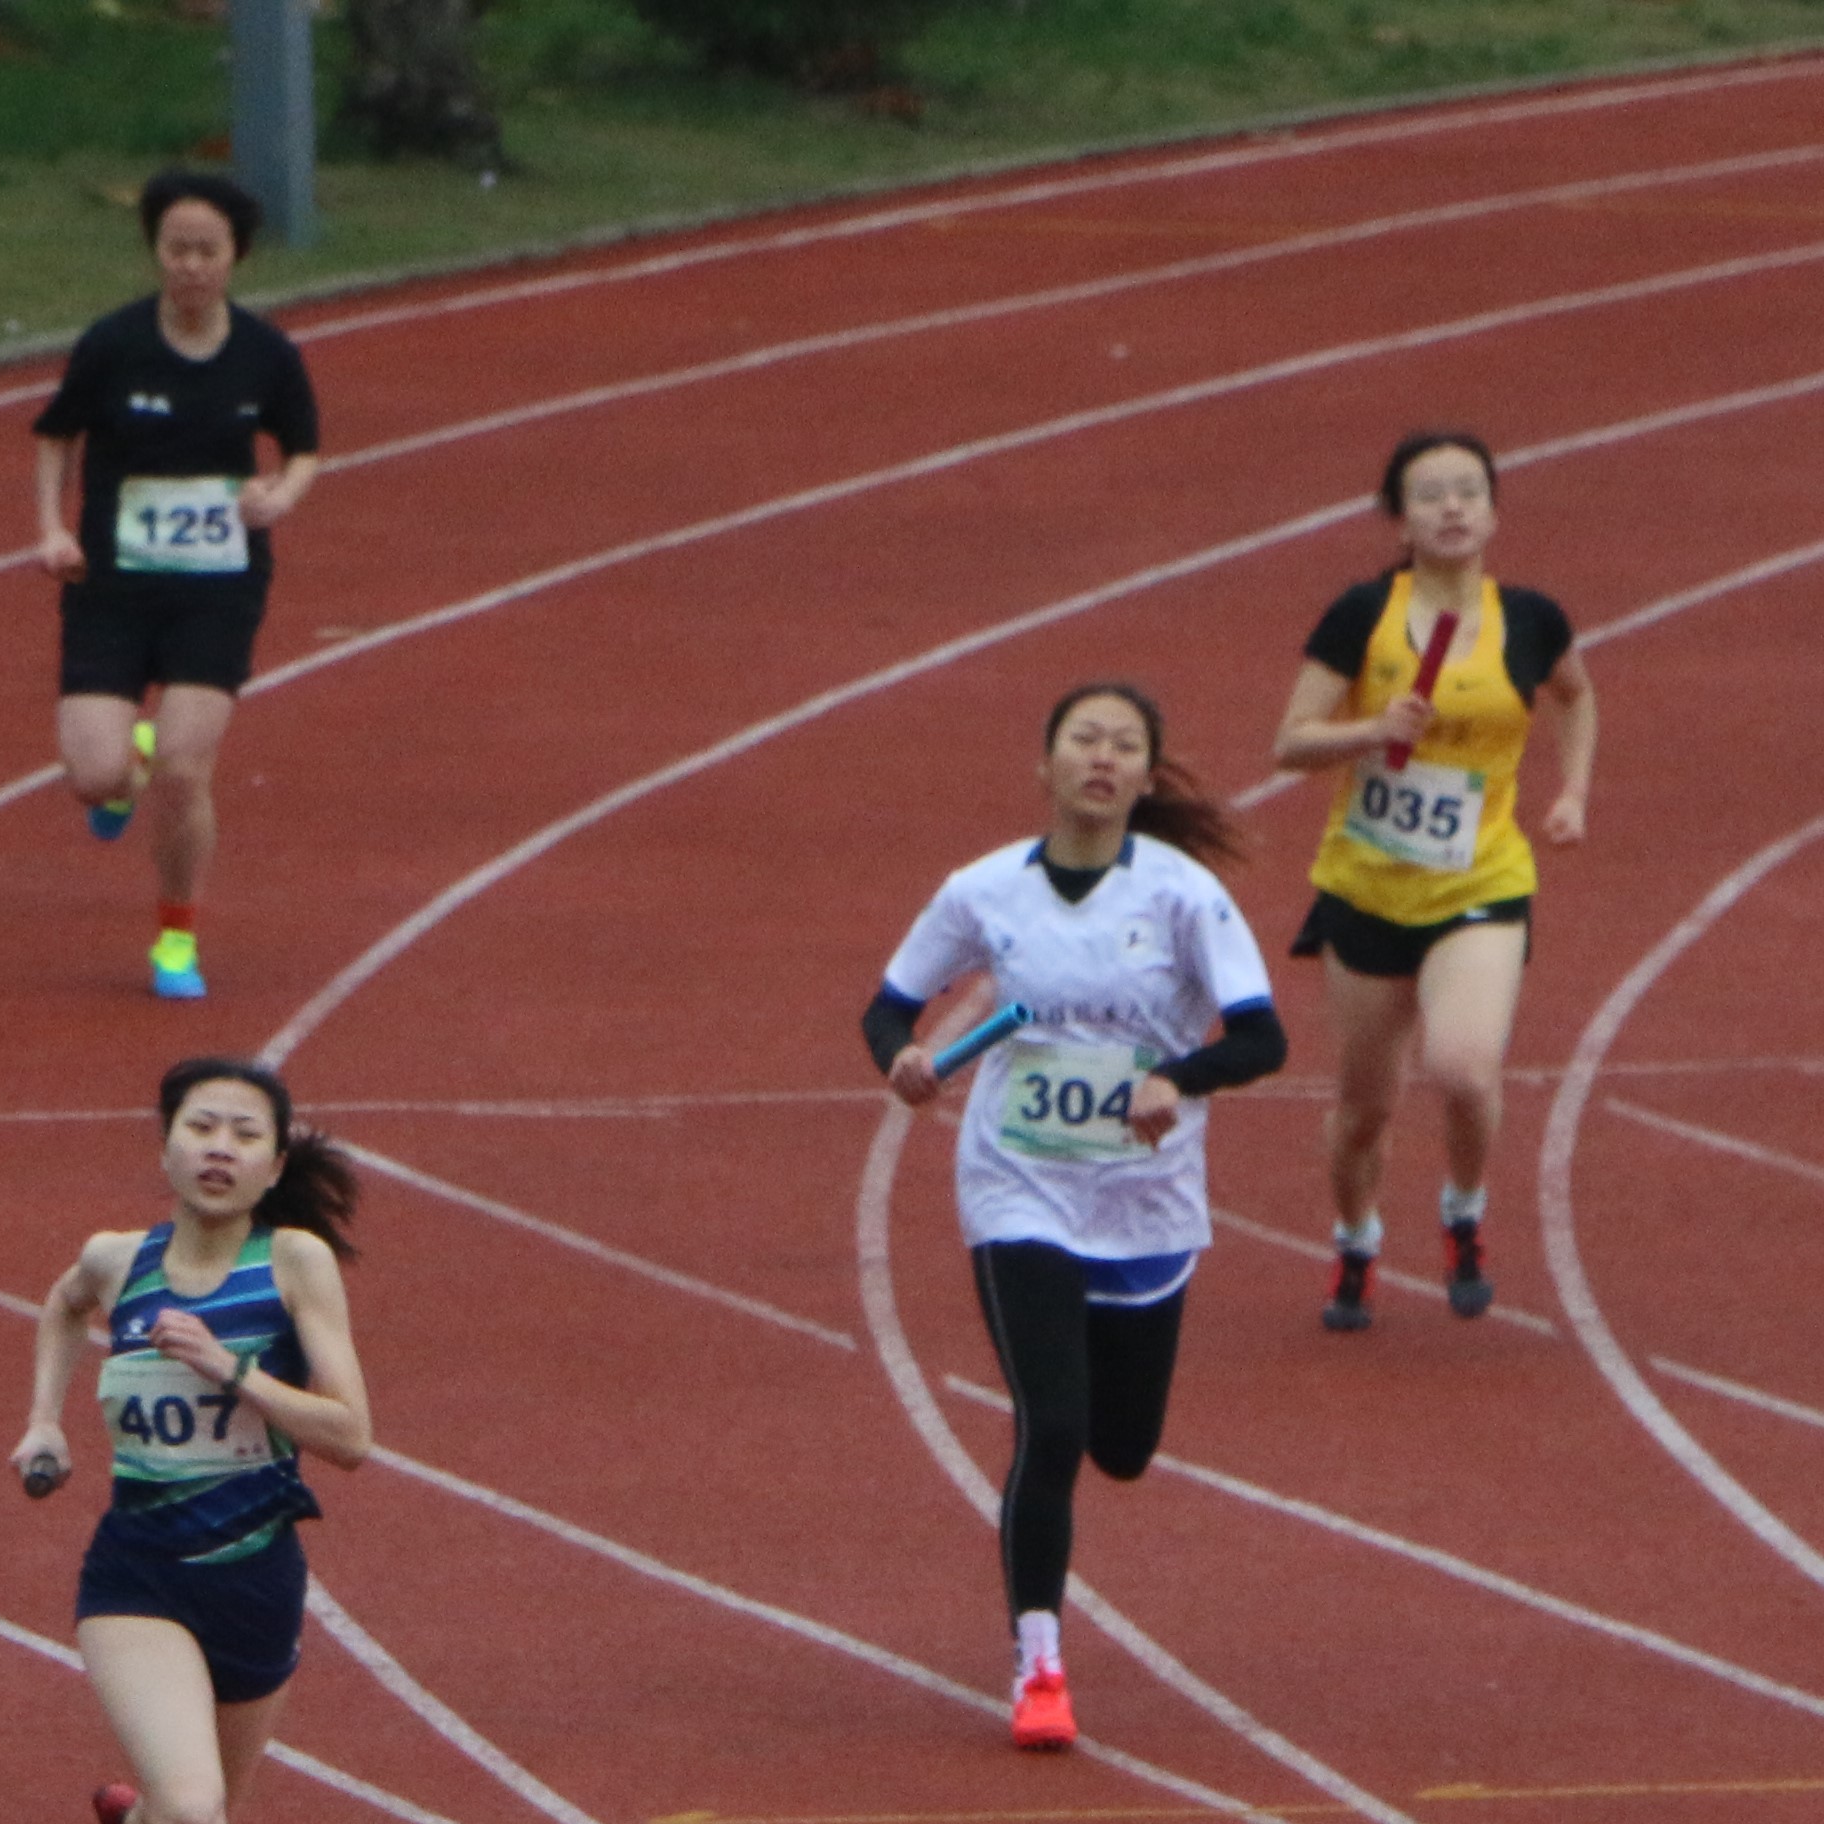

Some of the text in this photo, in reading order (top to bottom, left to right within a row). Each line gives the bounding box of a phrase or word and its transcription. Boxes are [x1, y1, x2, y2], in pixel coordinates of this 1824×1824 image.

[138, 506, 230, 545] 125
[1362, 777, 1462, 839] 035
[1020, 1071, 1134, 1126] 304
[119, 1393, 239, 1447] 407
